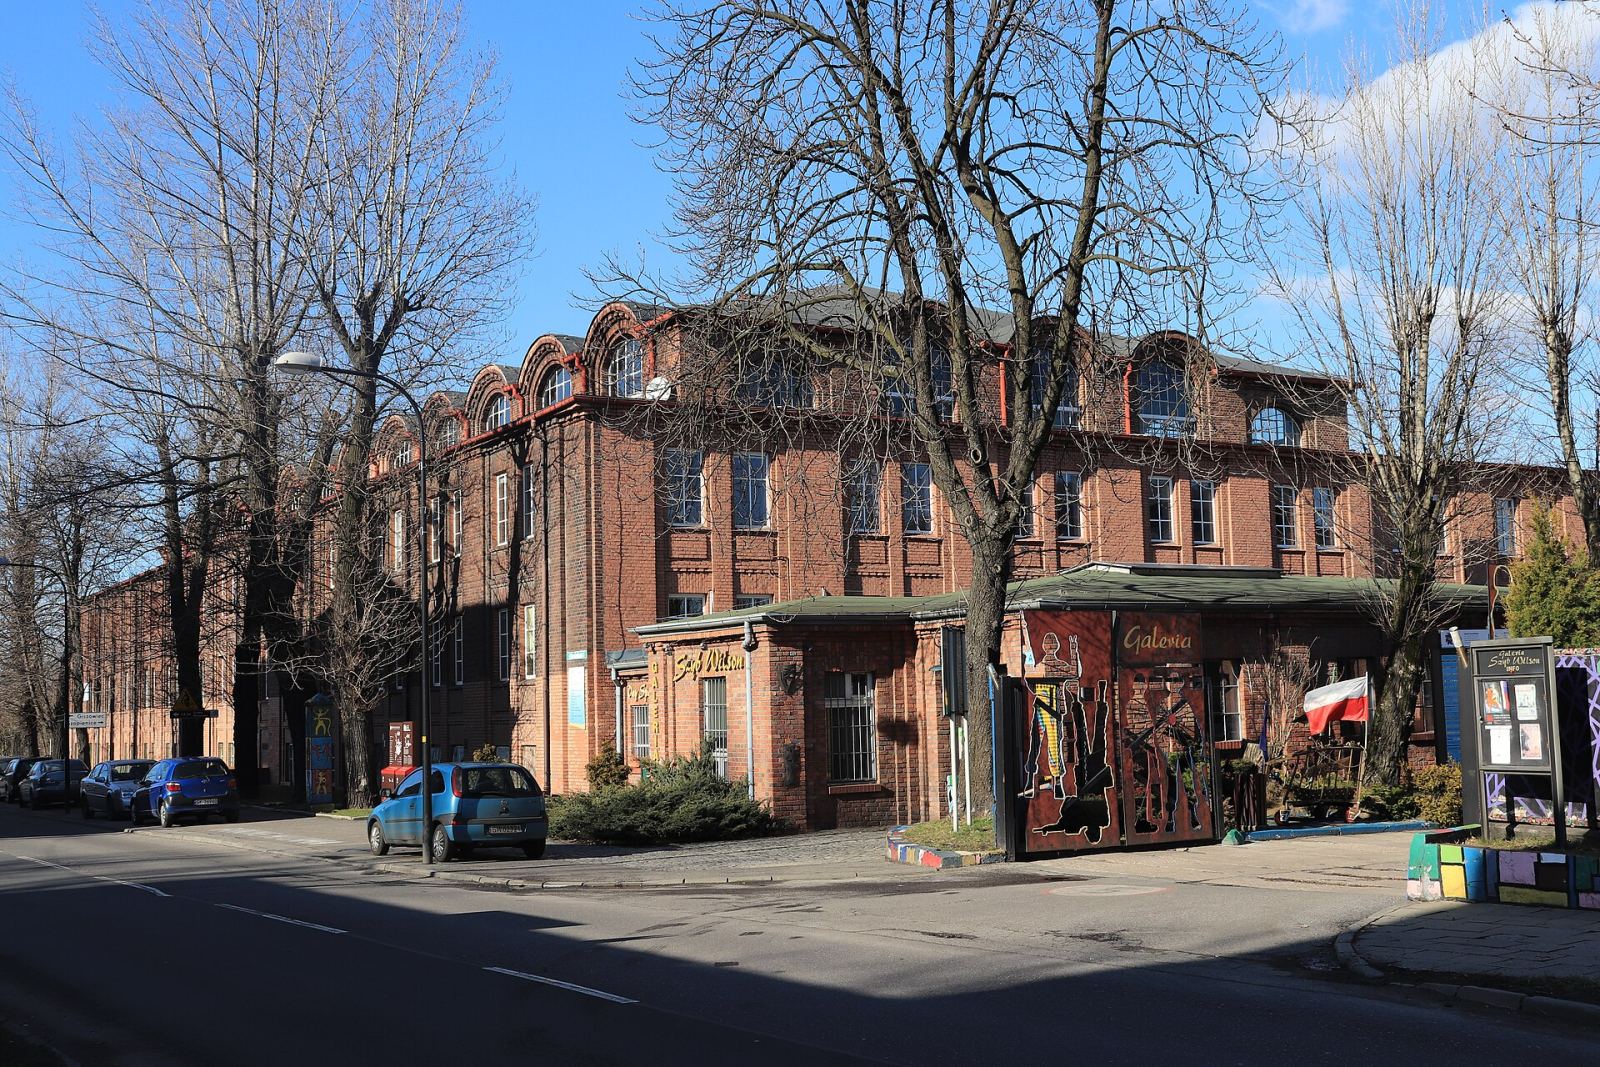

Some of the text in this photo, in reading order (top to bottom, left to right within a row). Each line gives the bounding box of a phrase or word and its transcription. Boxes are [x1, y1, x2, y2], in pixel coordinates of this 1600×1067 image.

[1123, 625, 1192, 655] Galeria
[1499, 650, 1525, 658] Galeria
[673, 649, 744, 682] Szyb Wilson
[1488, 656, 1540, 667] Szyb Wilson
[652, 661, 660, 762] GALERIA
